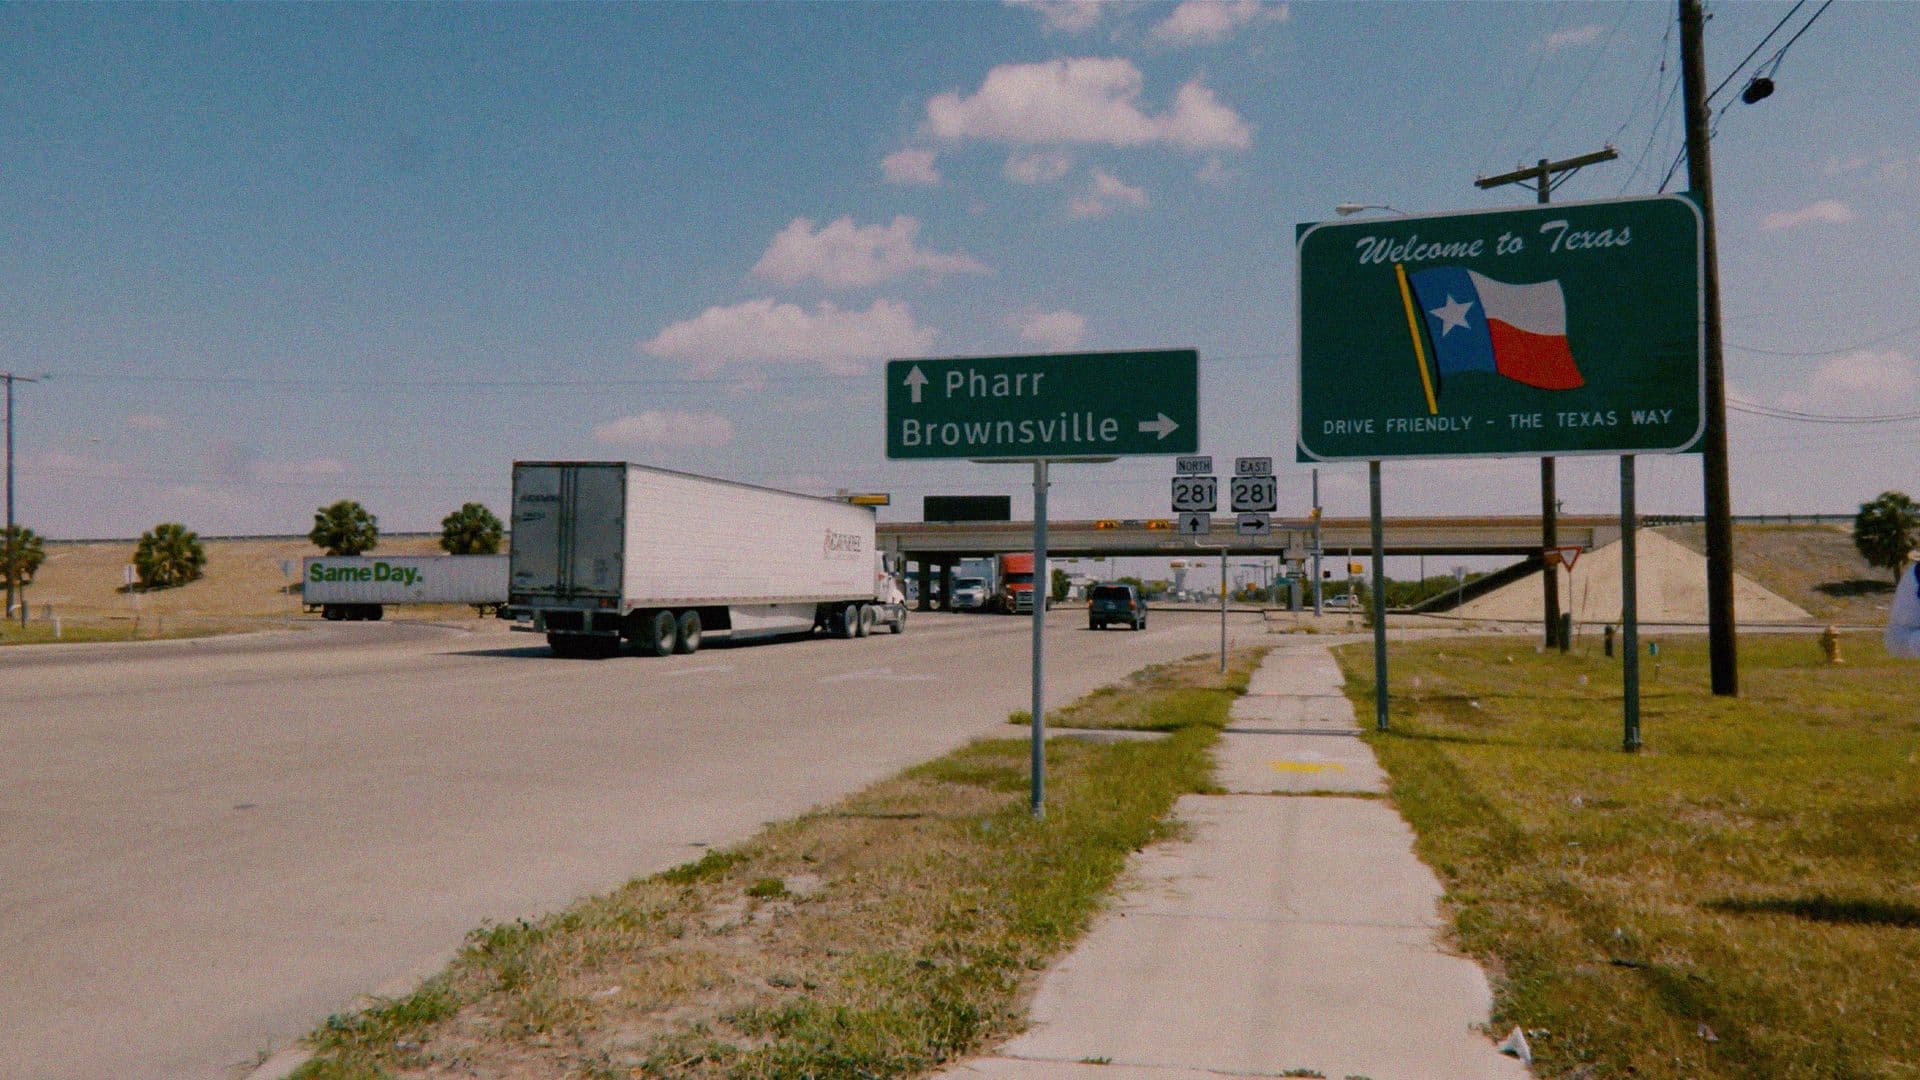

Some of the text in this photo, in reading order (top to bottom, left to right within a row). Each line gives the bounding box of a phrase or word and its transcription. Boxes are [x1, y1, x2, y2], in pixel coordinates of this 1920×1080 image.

[1356, 220, 1631, 265] Welcome to Texas
[946, 368, 1044, 399] Pharr
[902, 411, 1119, 447] Brownsville
[1323, 419, 1374, 435] DRIVE
[1386, 415, 1472, 433] FRIENDLY
[1509, 414, 1543, 430] THE
[1557, 411, 1617, 427] TEXAS
[1631, 409, 1673, 425] WAY
[1178, 460, 1210, 472] NORTH
[1240, 460, 1267, 471] EAST
[1176, 484, 1213, 504] 281
[1235, 484, 1273, 504] 281
[310, 562, 424, 587] Same Day.
